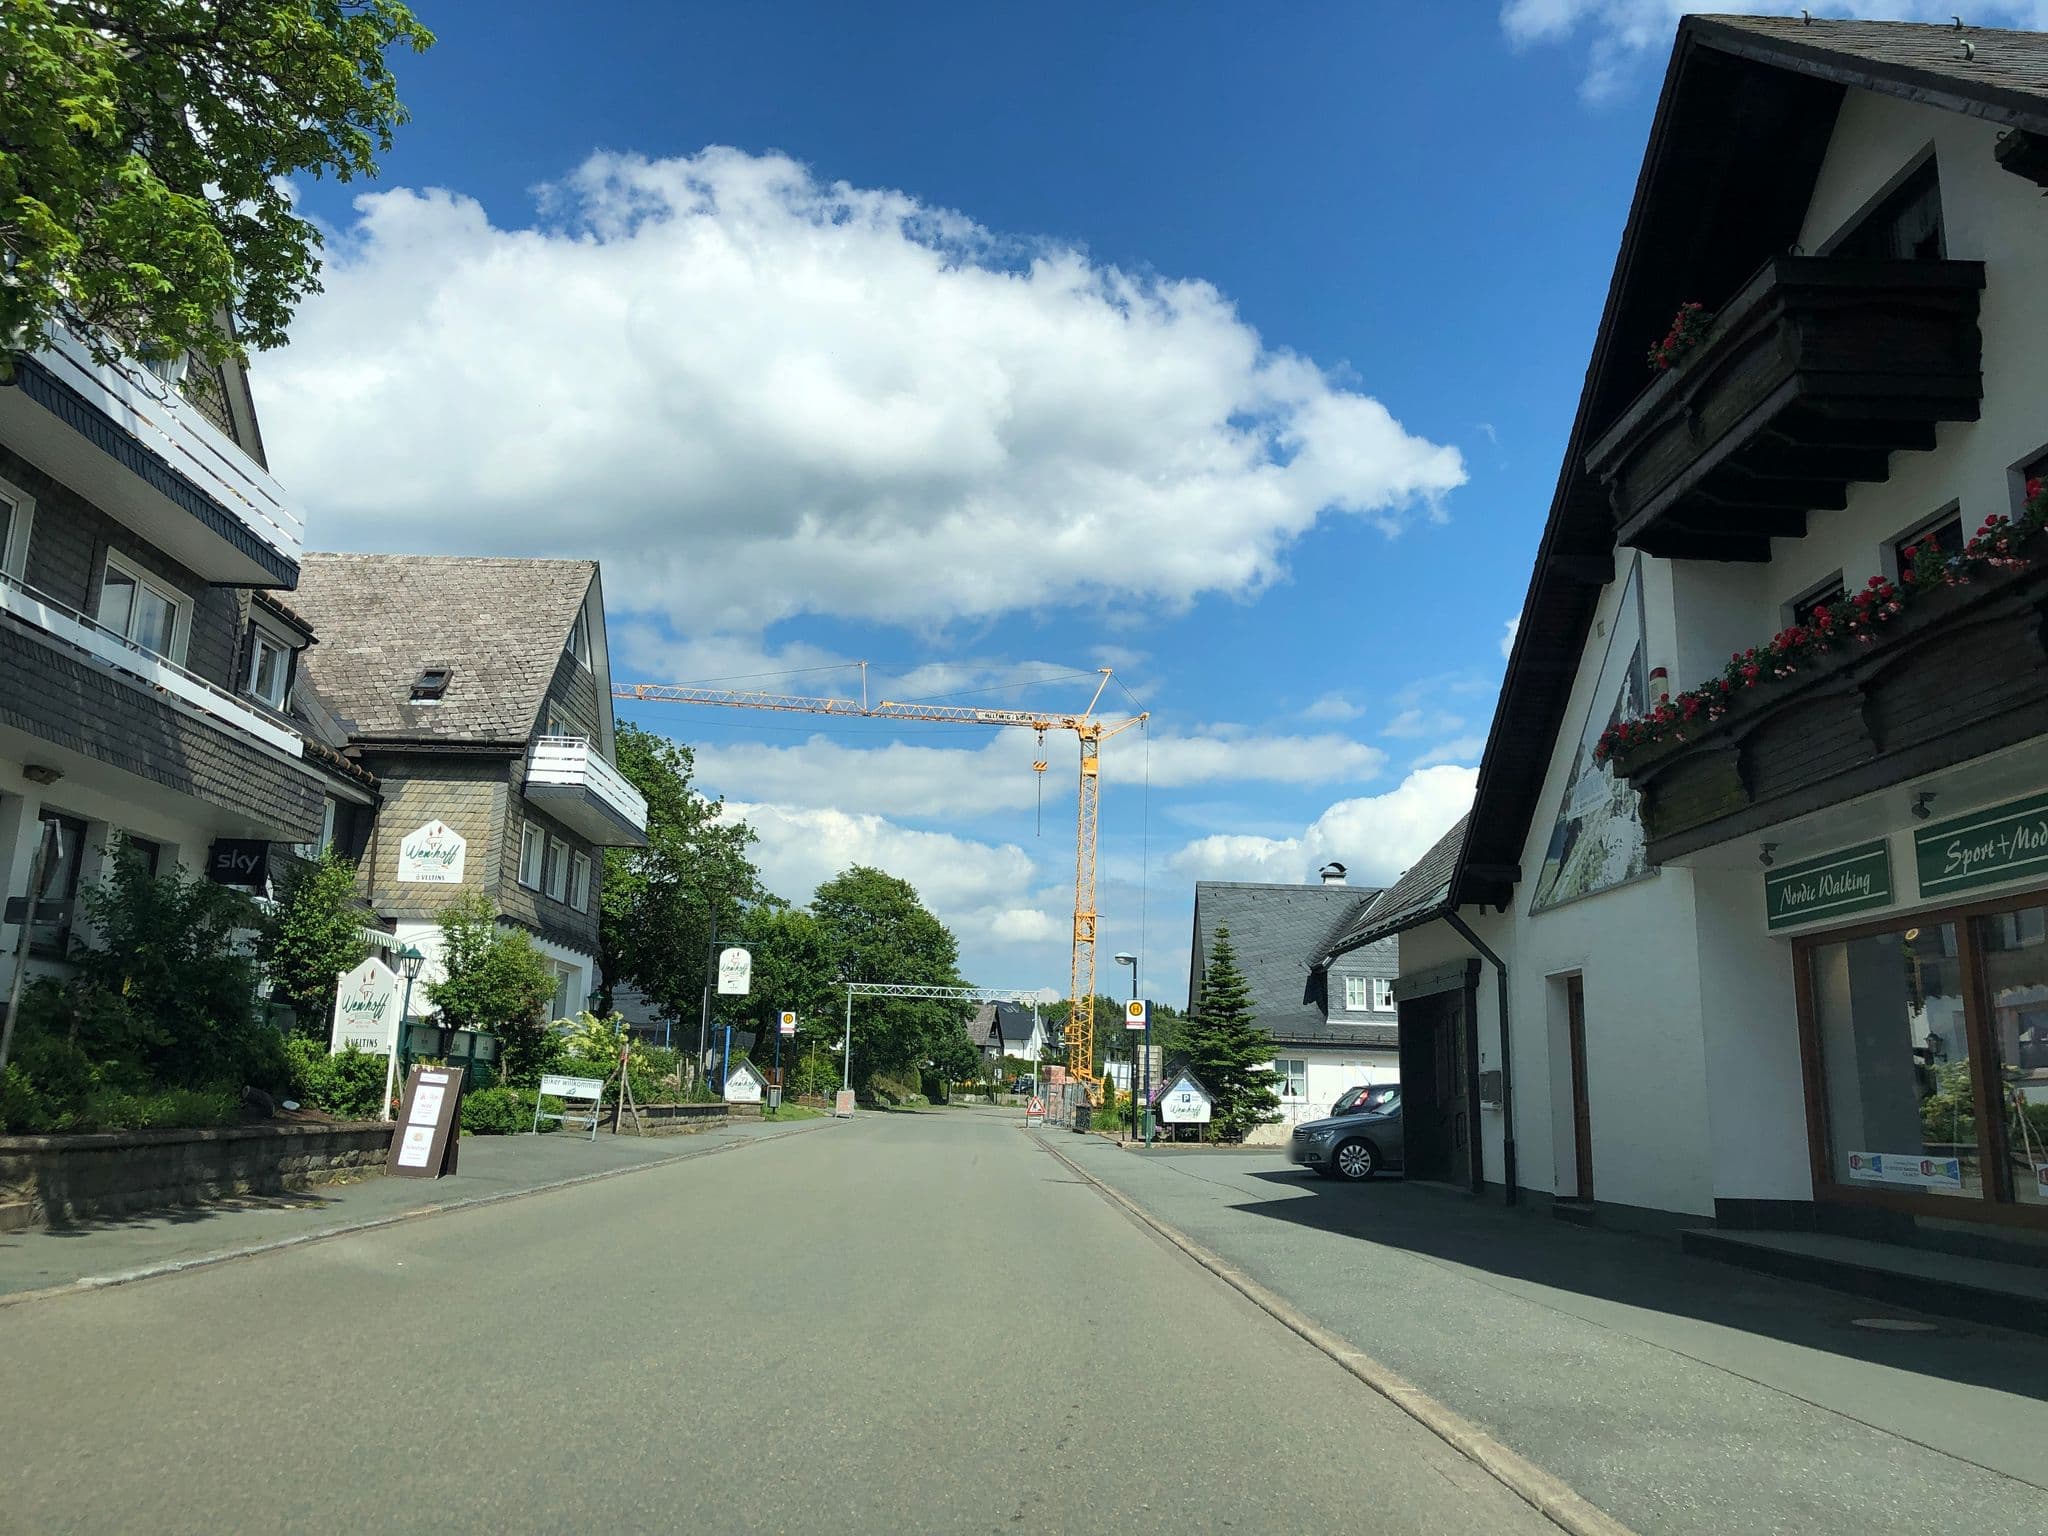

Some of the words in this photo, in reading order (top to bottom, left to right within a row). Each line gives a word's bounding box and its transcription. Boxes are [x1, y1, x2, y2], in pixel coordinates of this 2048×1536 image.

[217, 848, 260, 875] sky
[1780, 884, 1816, 912] Nordic
[1818, 870, 1871, 898] Walking
[350, 1038, 378, 1048] VELTINS
[543, 1077, 561, 1085] Biker
[562, 1079, 601, 1089] willkommen
